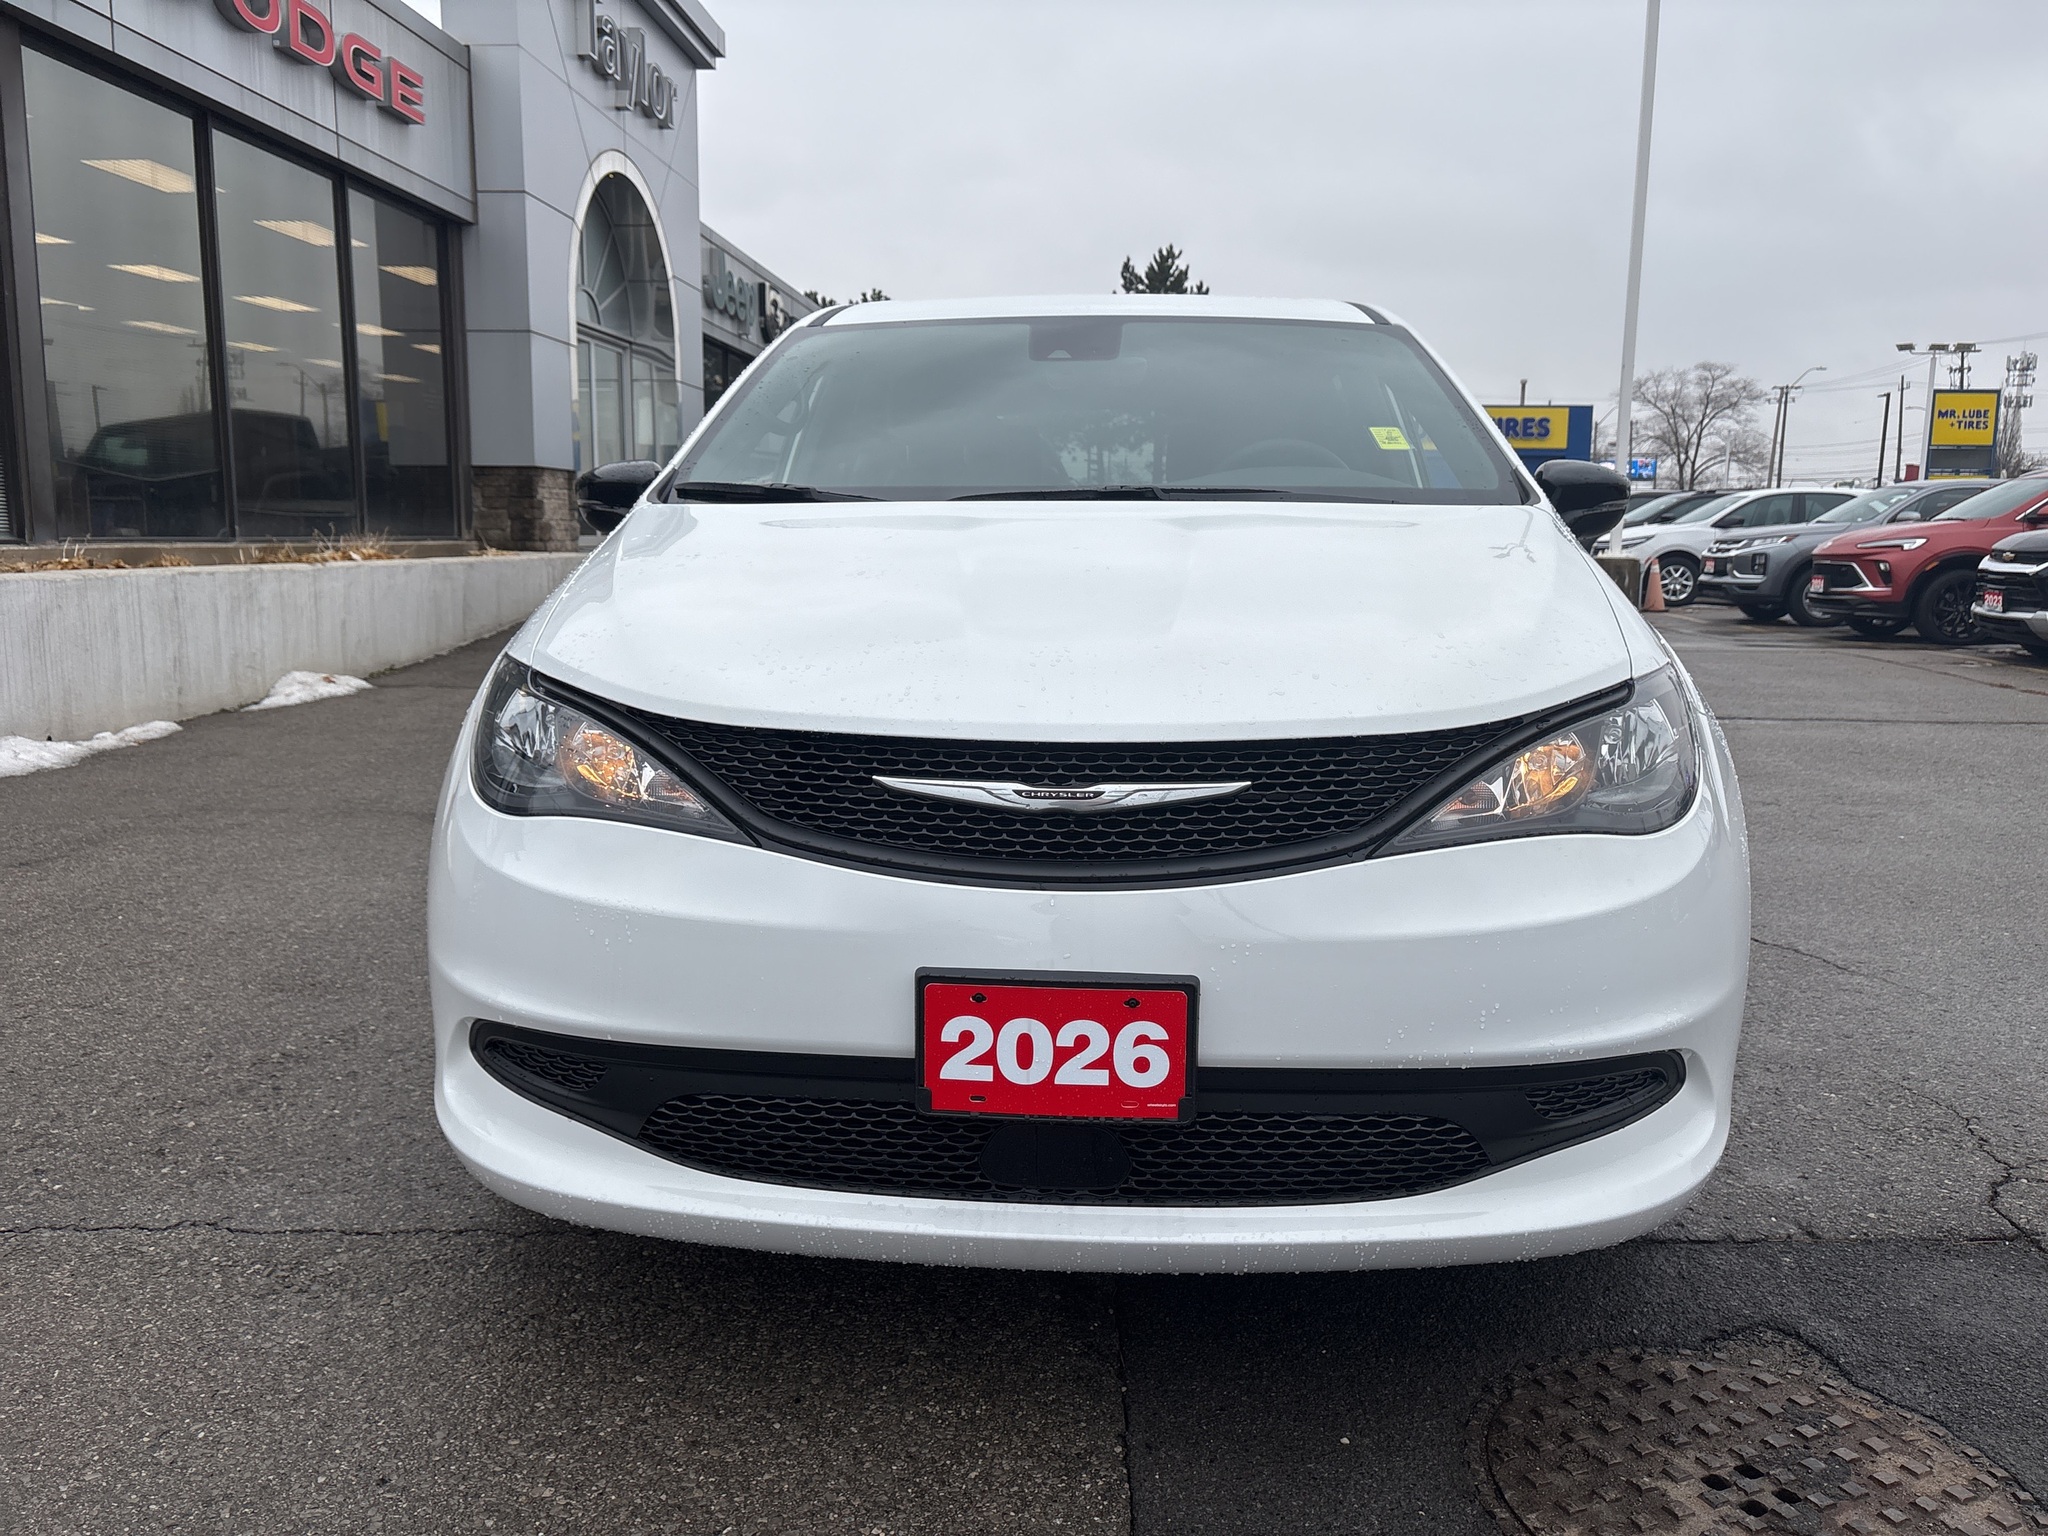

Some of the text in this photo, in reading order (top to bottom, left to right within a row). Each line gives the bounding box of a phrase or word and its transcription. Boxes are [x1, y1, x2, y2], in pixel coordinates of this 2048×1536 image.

[704, 247, 757, 329] Jeep
[1938, 409, 1990, 419] MR. LUBE
[1494, 417, 1551, 438] IRES
[1957, 420, 1989, 430] TIRES
[939, 1015, 1170, 1088] 2026
